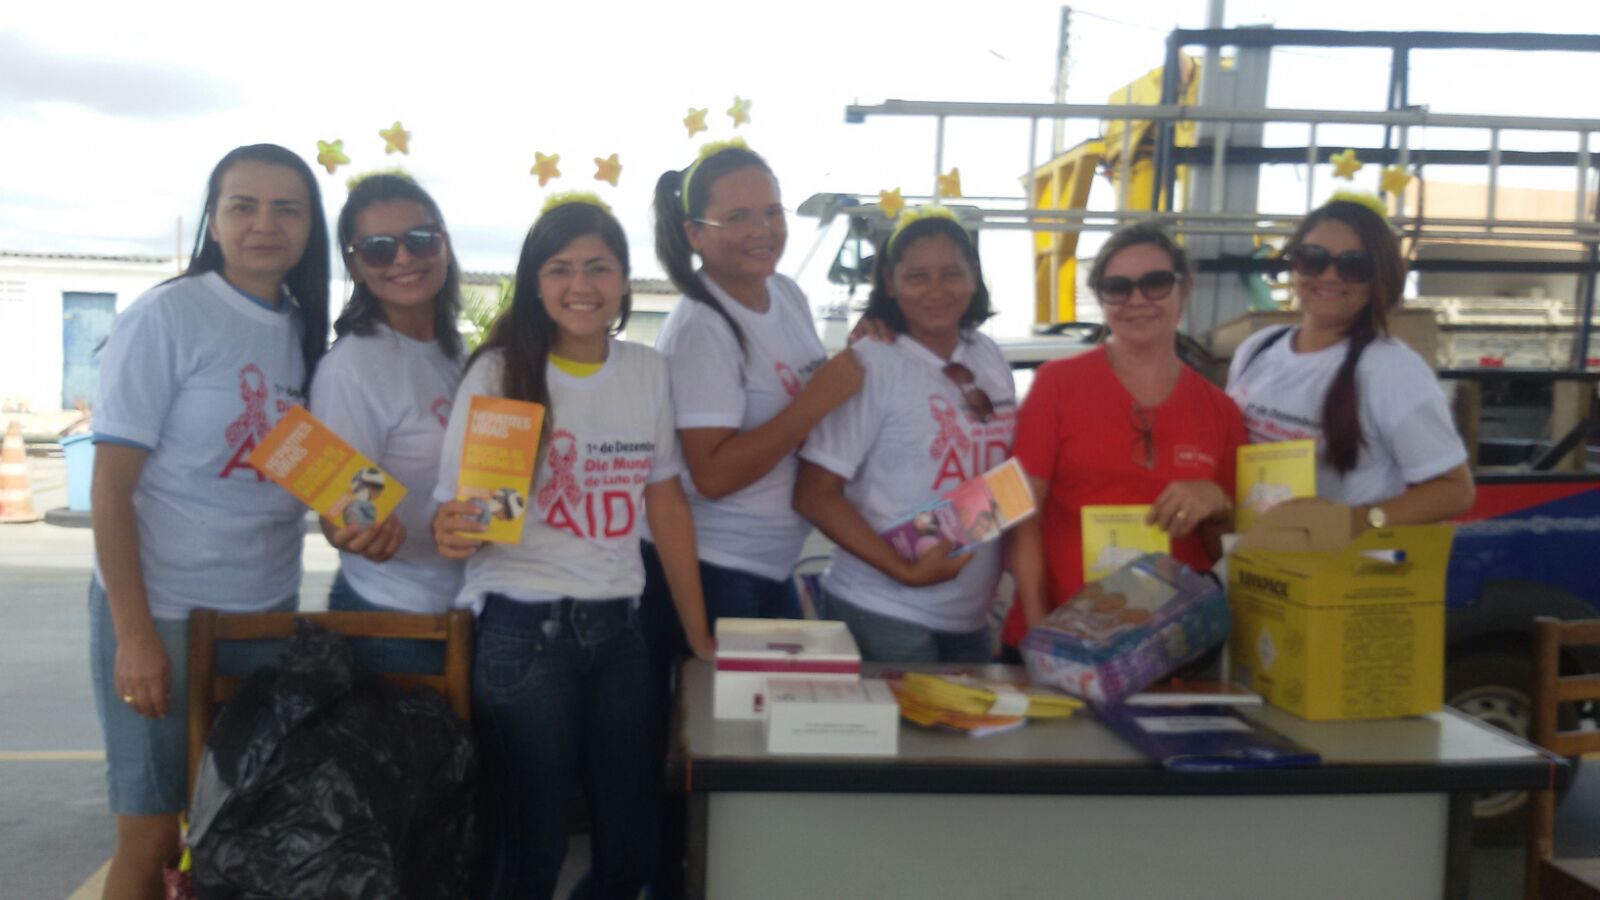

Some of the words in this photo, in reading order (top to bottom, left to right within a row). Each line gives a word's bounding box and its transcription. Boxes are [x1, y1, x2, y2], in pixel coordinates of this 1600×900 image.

[600, 442, 614, 453] de
[931, 440, 1010, 491] AID
[546, 491, 645, 539] AID
